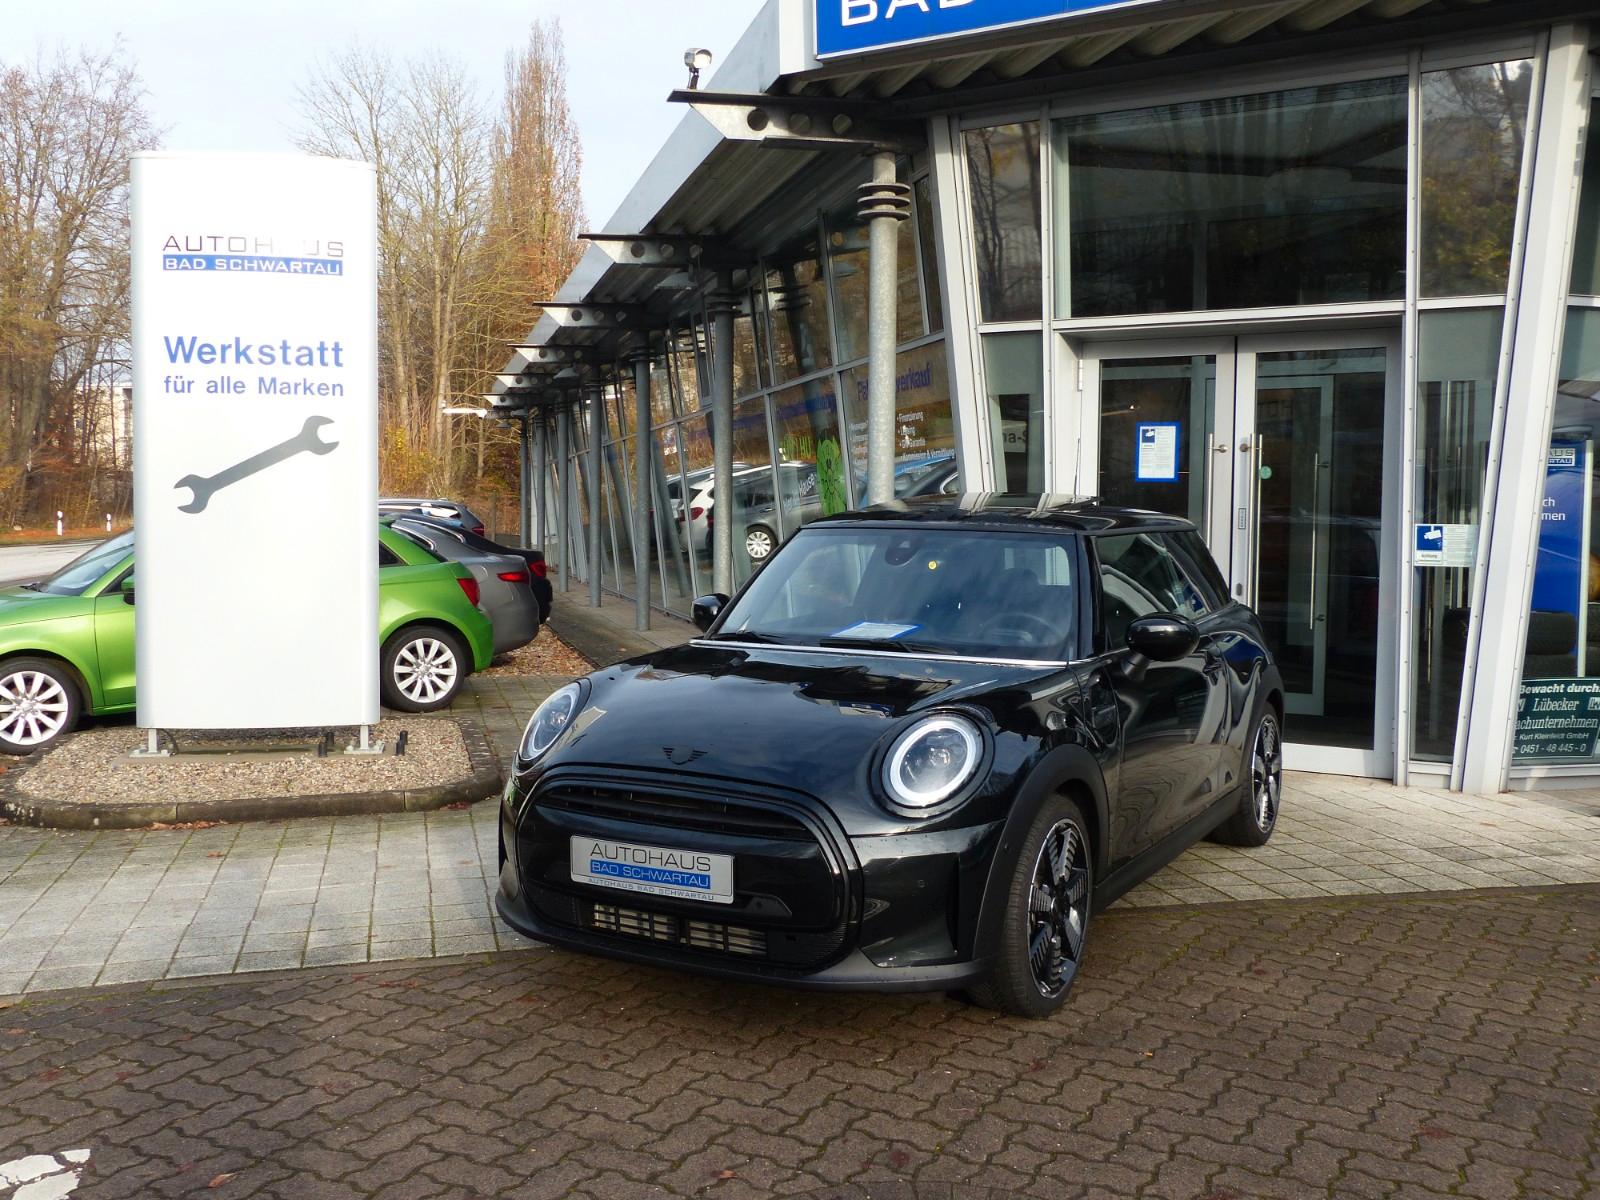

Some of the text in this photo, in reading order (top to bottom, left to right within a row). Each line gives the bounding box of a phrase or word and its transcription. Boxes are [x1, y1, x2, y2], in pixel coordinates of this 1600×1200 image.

[163, 235, 344, 258] AUTOHUS
[166, 258, 341, 275] BAD SCHWARTAU
[164, 336, 344, 368] Werkstatt
[164, 376, 344, 397] für alle Marken
[1532, 697, 1580, 712] Lübecker
[1514, 715, 1599, 730] achunternehmen
[1566, 732, 1590, 740] GmbH
[1520, 743, 1540, 754] 0451
[590, 843, 711, 871] AUTOHAUS
[592, 862, 709, 887] BAD SCHWARTAU
[589, 878, 634, 890] AUTOHAUS
[658, 889, 714, 901] SCHWARTAU
